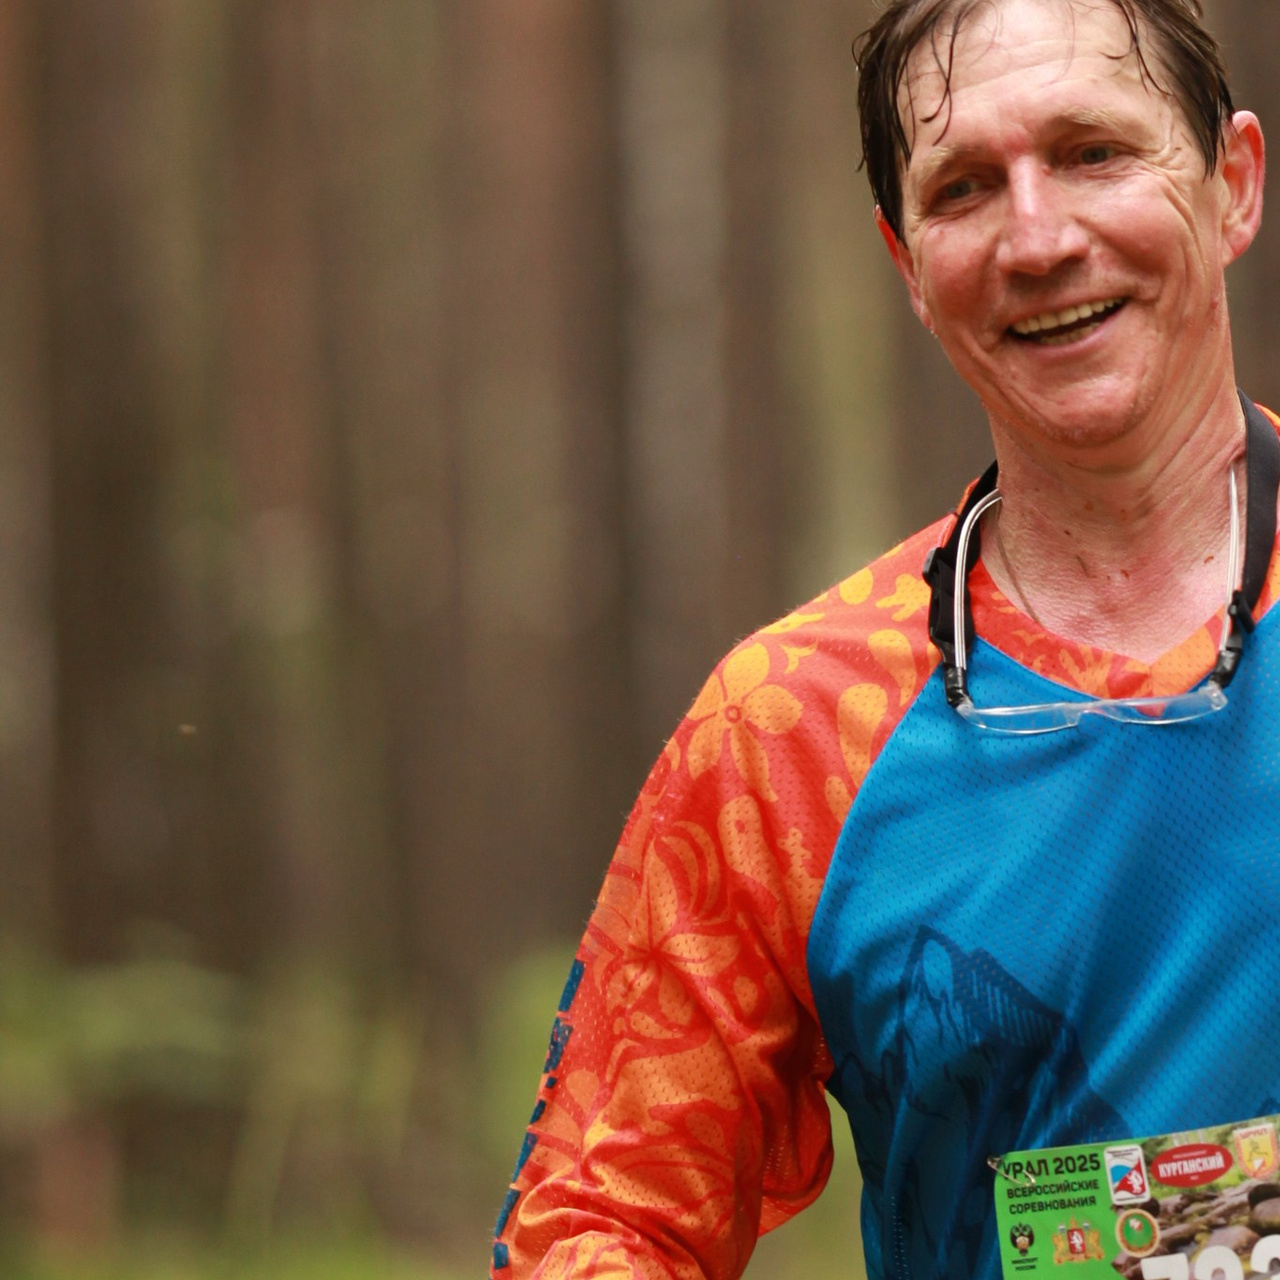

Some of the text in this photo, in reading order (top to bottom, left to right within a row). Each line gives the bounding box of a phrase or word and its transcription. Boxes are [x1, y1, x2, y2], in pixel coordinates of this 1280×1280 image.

[1001, 1153, 1101, 1181] УРАЛ 2025
[1157, 1151, 1226, 1179] КУРГАНСКИЙ
[1006, 1179, 1100, 1199] ВСЕРОССИЙСКИЕ
[1009, 1196, 1097, 1215] СОРЕВНОВАНИЯ
